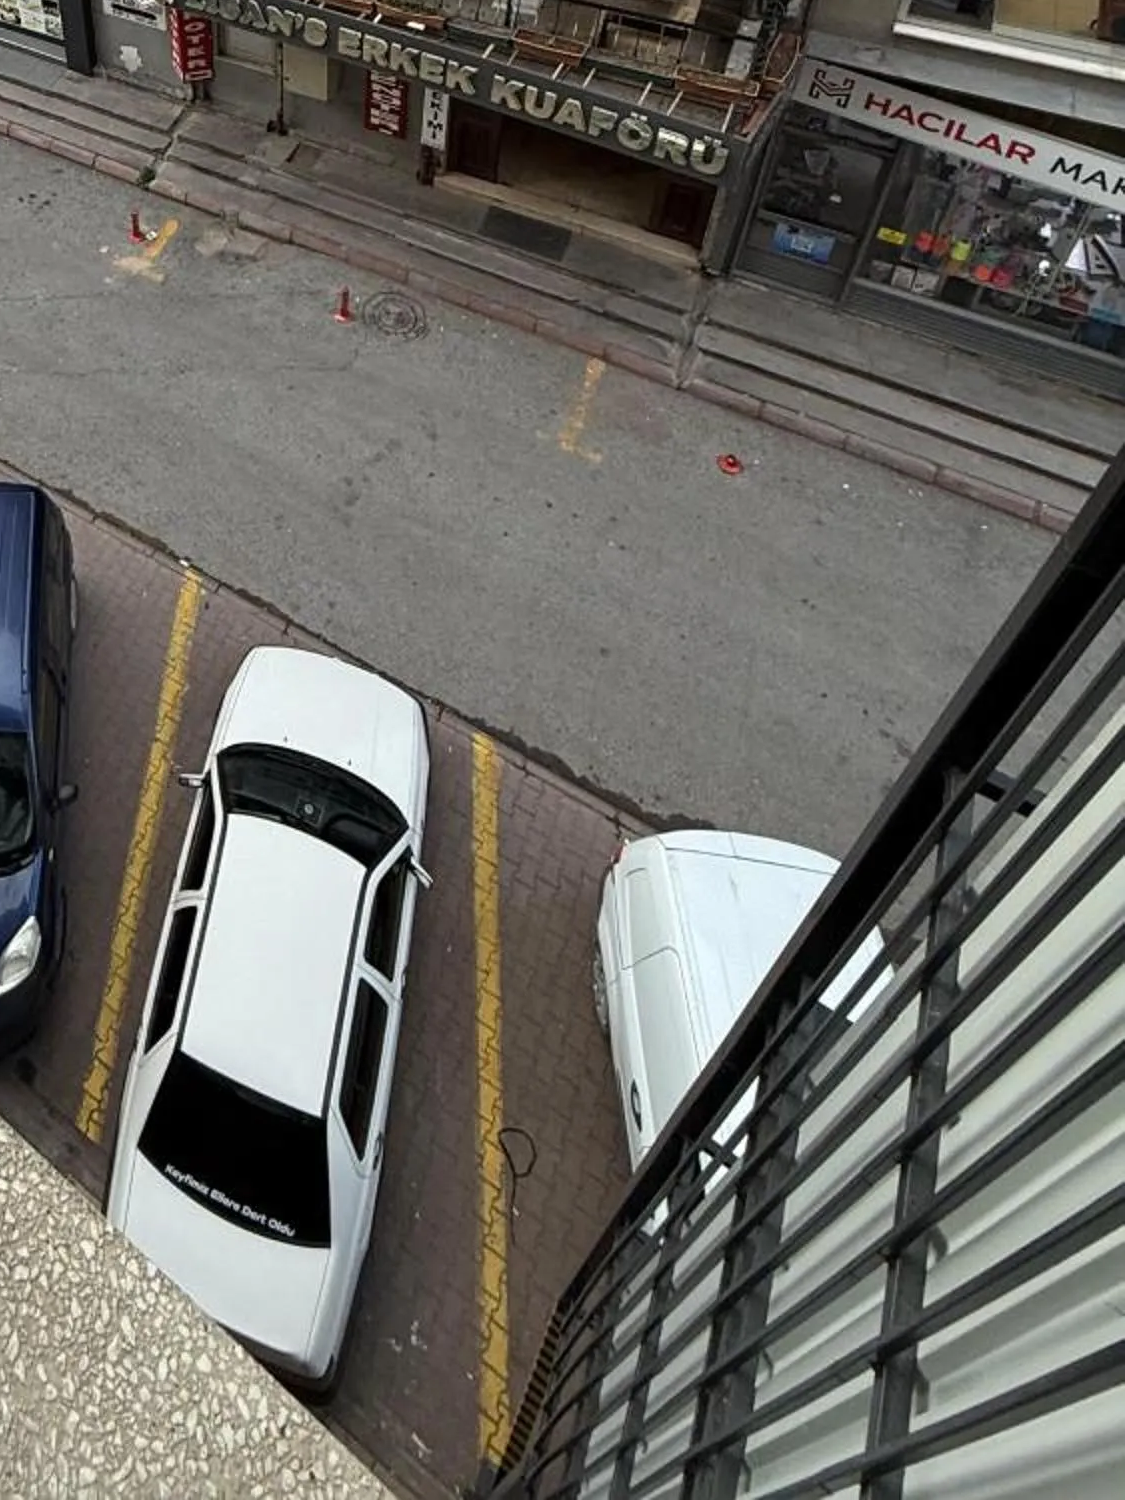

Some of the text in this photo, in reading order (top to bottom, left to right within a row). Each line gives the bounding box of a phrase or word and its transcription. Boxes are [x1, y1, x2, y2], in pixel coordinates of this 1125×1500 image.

[338, 26, 479, 95] ERKEK
[491, 74, 730, 176] KUAFÖRÜ
[864, 91, 1037, 164] HACILAR
